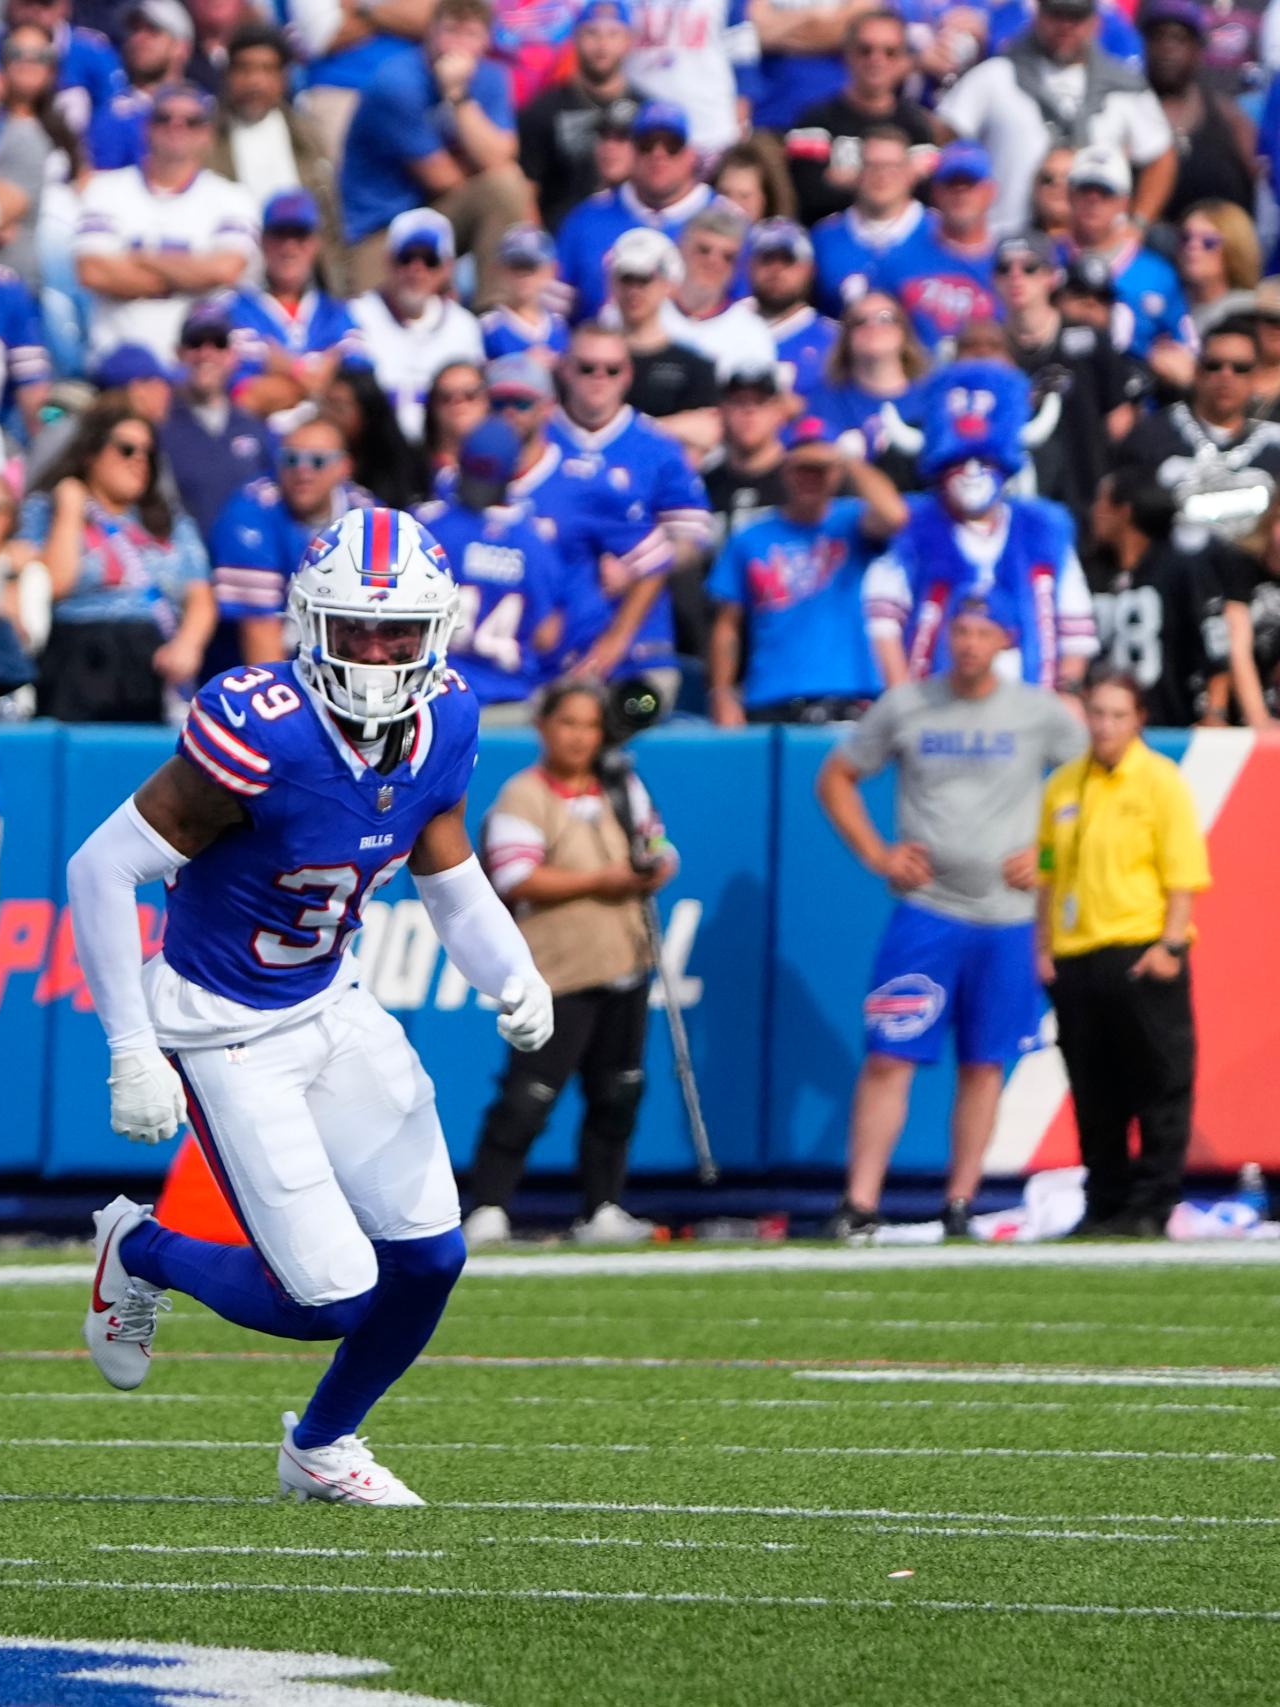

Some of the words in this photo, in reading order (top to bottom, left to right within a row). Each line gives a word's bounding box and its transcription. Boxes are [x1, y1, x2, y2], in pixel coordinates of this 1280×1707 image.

[222, 664, 302, 722] 39
[920, 730, 1018, 757] BILLS
[359, 833, 394, 850] BILLS
